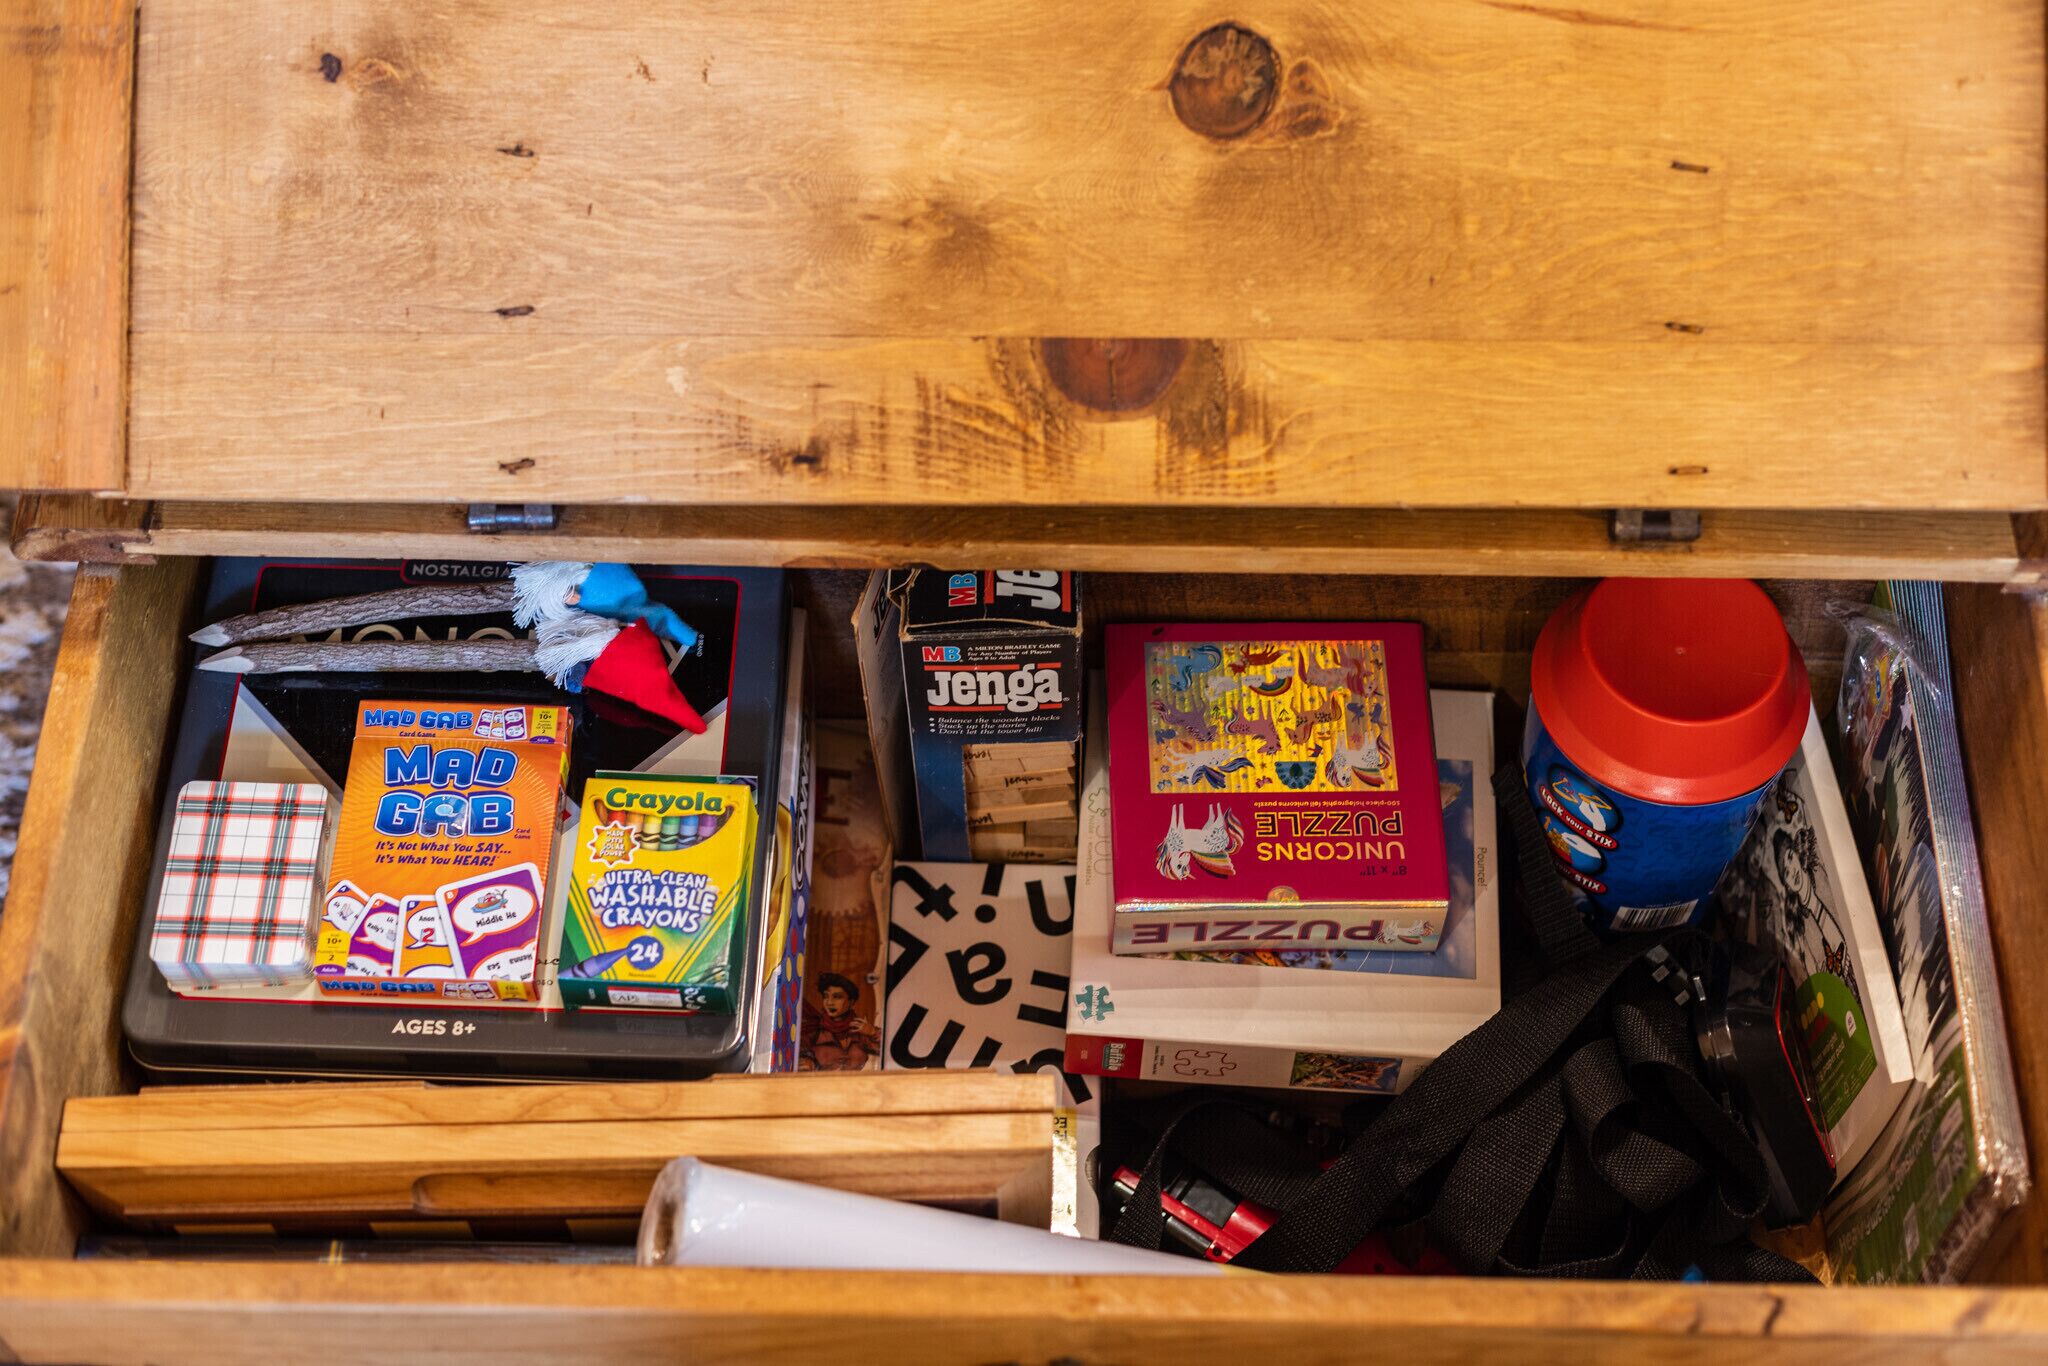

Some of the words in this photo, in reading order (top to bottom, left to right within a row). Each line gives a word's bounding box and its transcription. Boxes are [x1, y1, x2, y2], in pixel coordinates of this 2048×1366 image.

[927, 664, 1063, 713] Jenga
[364, 708, 417, 727] MAD
[419, 711, 474, 730] GAB
[1031, 714, 1061, 722] blocks
[1025, 726, 1043, 735] fall!
[384, 745, 518, 789] MAD
[606, 788, 723, 814] Crayola
[1253, 799, 1278, 807] puzzle
[1309, 800, 1321, 808] foil
[1322, 800, 1365, 808] holographic
[374, 789, 515, 838] GAB
[1254, 810, 1403, 837] PUZZLE
[1541, 787, 1564, 816] LOCK
[1585, 829, 1614, 848] STIX
[375, 841, 394, 851] It's
[397, 842, 418, 851] Not
[420, 843, 449, 852] What
[453, 843, 473, 853] You
[475, 843, 511, 854] SAY...
[1256, 841, 1406, 861] UNICORNS
[375, 854, 394, 864] It's
[397, 855, 427, 865] What
[431, 856, 451, 866] You
[453, 855, 497, 867] HEAR!
[605, 870, 707, 890] ULTRA-CLEAN
[1574, 873, 1601, 891] STIX
[588, 885, 717, 916] WASHABLE
[475, 916, 504, 928] Middle
[602, 908, 700, 933] CRAYONS
[421, 928, 434, 943] 2
[1131, 918, 1385, 945] PUZZLE
[630, 942, 660, 962] 24
[392, 1019, 447, 1036] AGES
[451, 1020, 477, 1036] 8+
[1108, 1042, 1124, 1072] Buffalo
